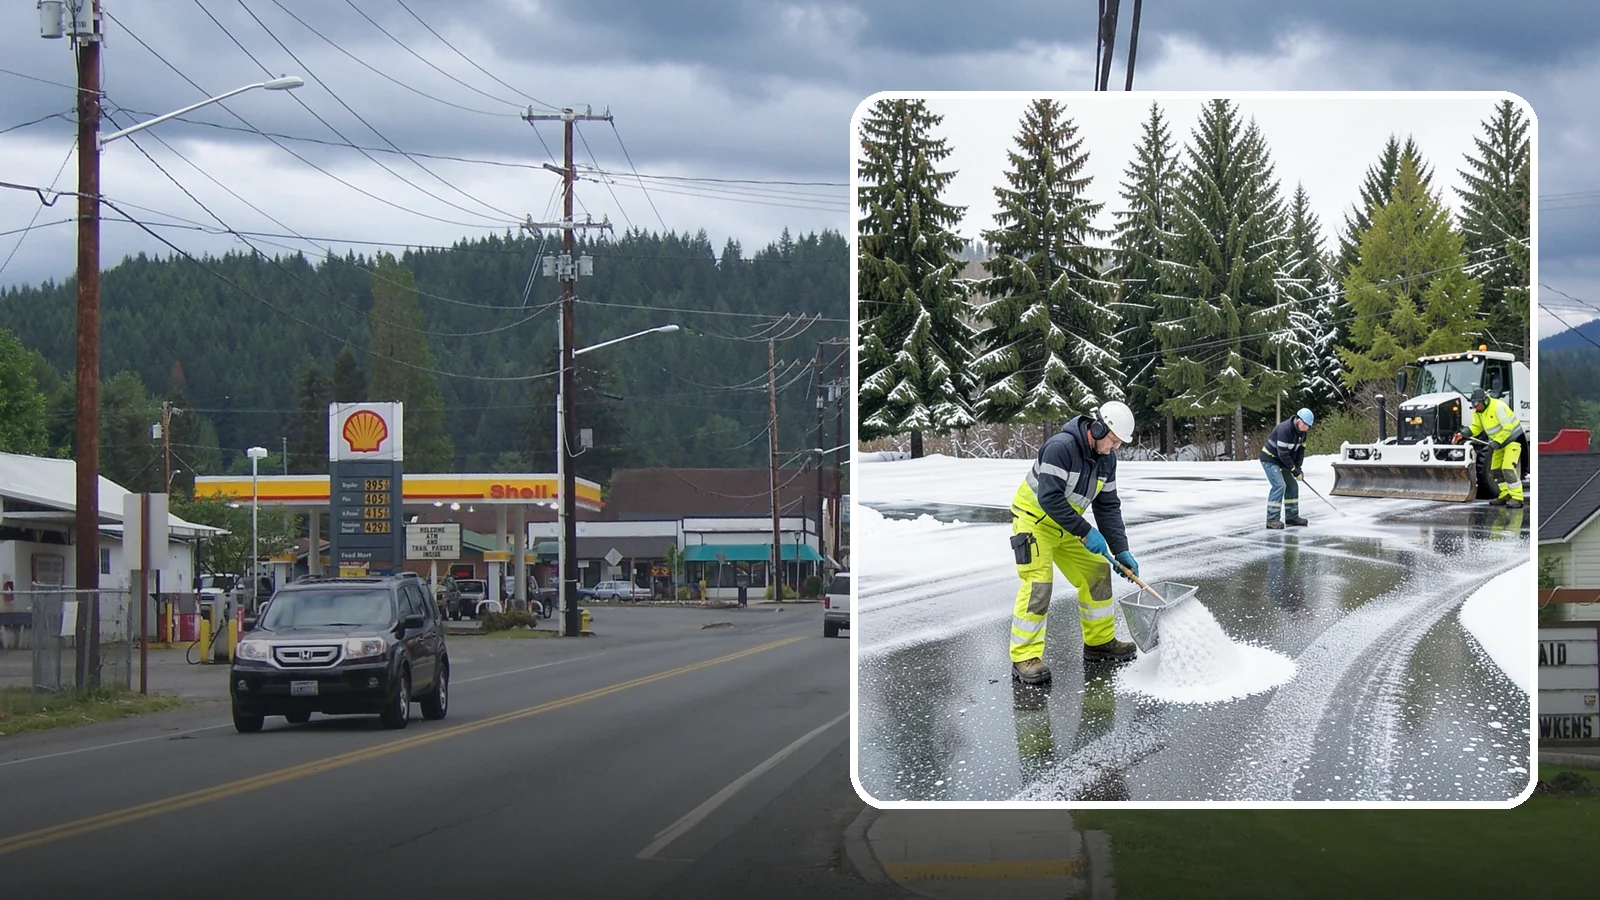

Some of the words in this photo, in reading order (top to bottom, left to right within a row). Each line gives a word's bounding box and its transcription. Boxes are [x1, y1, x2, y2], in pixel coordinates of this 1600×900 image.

[365, 480, 383, 490] 395
[490, 484, 547, 499] Shell
[365, 494, 383, 504] 405
[365, 508, 383, 518] 415
[365, 522, 383, 532] 429
